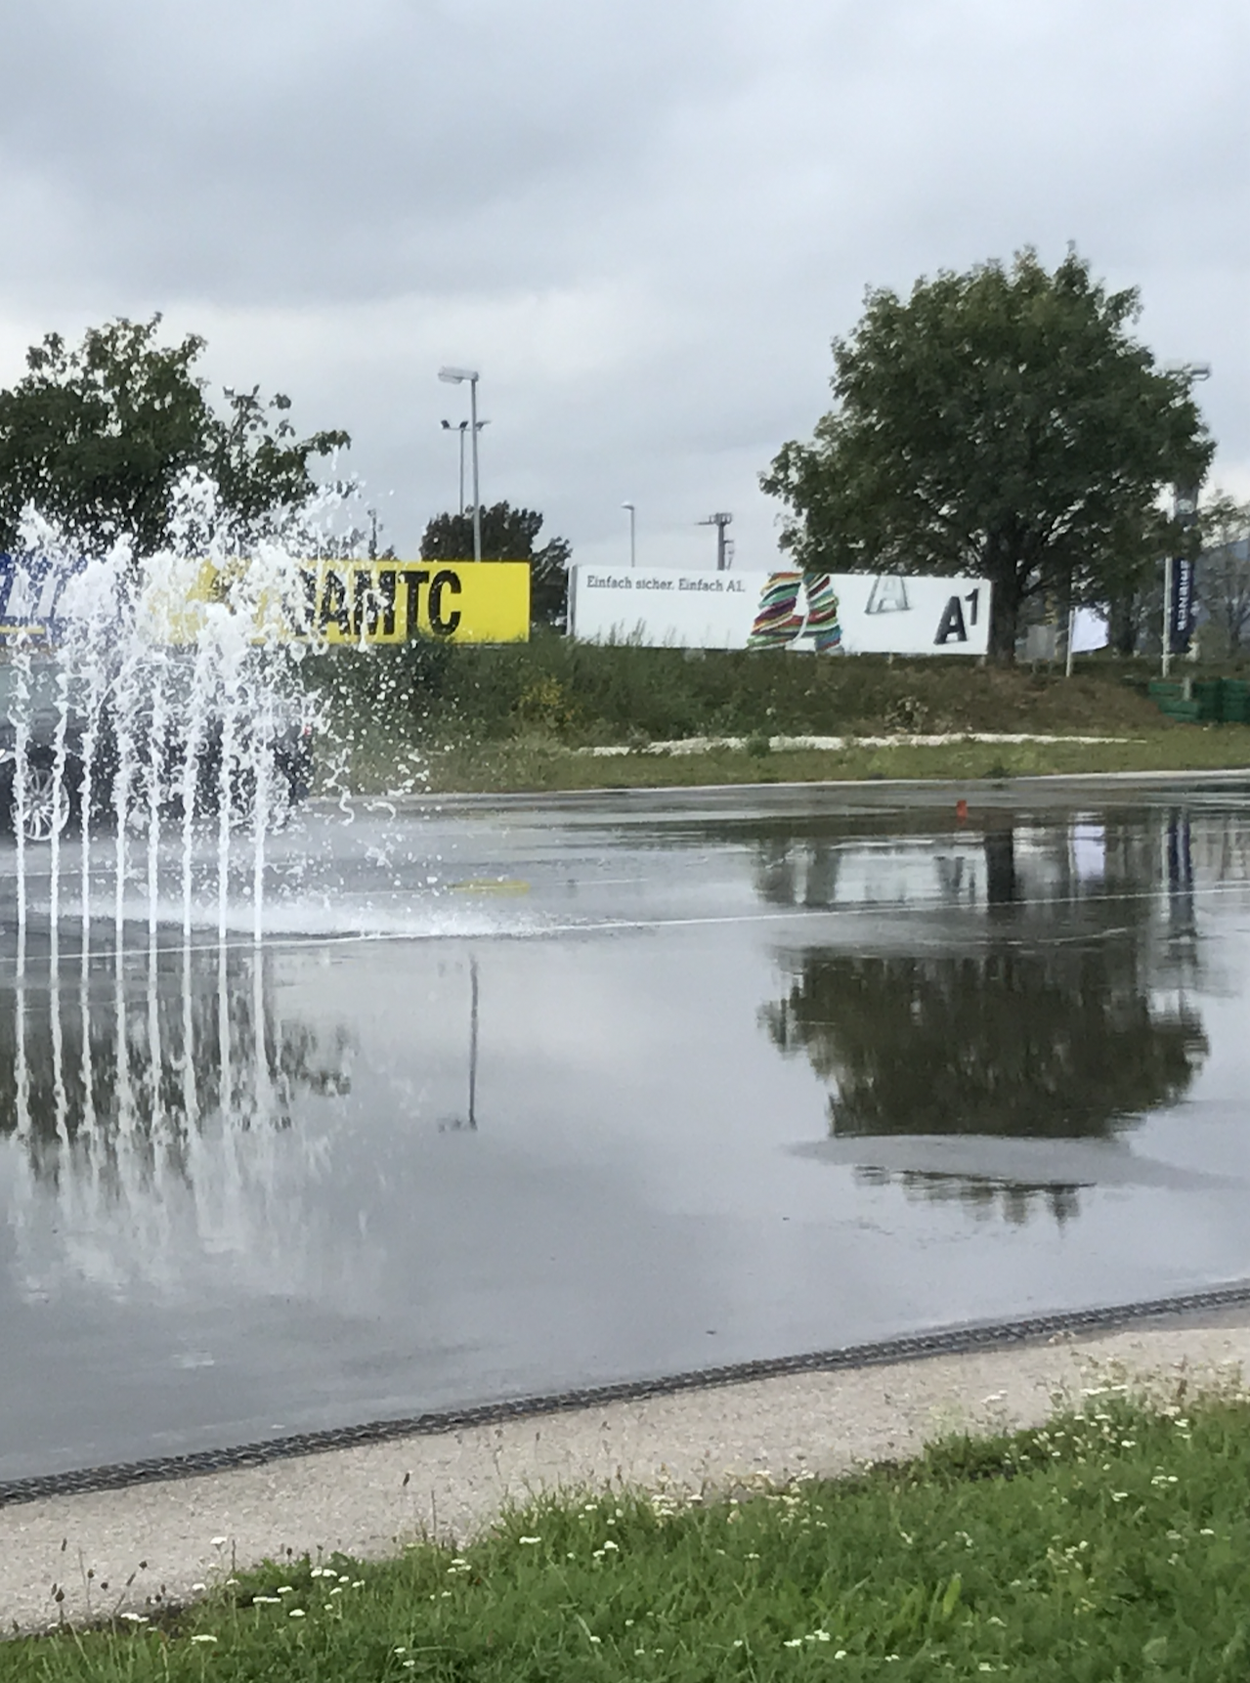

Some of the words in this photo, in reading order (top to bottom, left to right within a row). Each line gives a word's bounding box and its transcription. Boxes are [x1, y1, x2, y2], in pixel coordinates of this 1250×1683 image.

[587, 575, 632, 590] Einfach
[636, 577, 675, 591] sicher.
[678, 577, 724, 593] Einfach
[726, 580, 746, 593] A1.
[933, 587, 980, 646] A1
